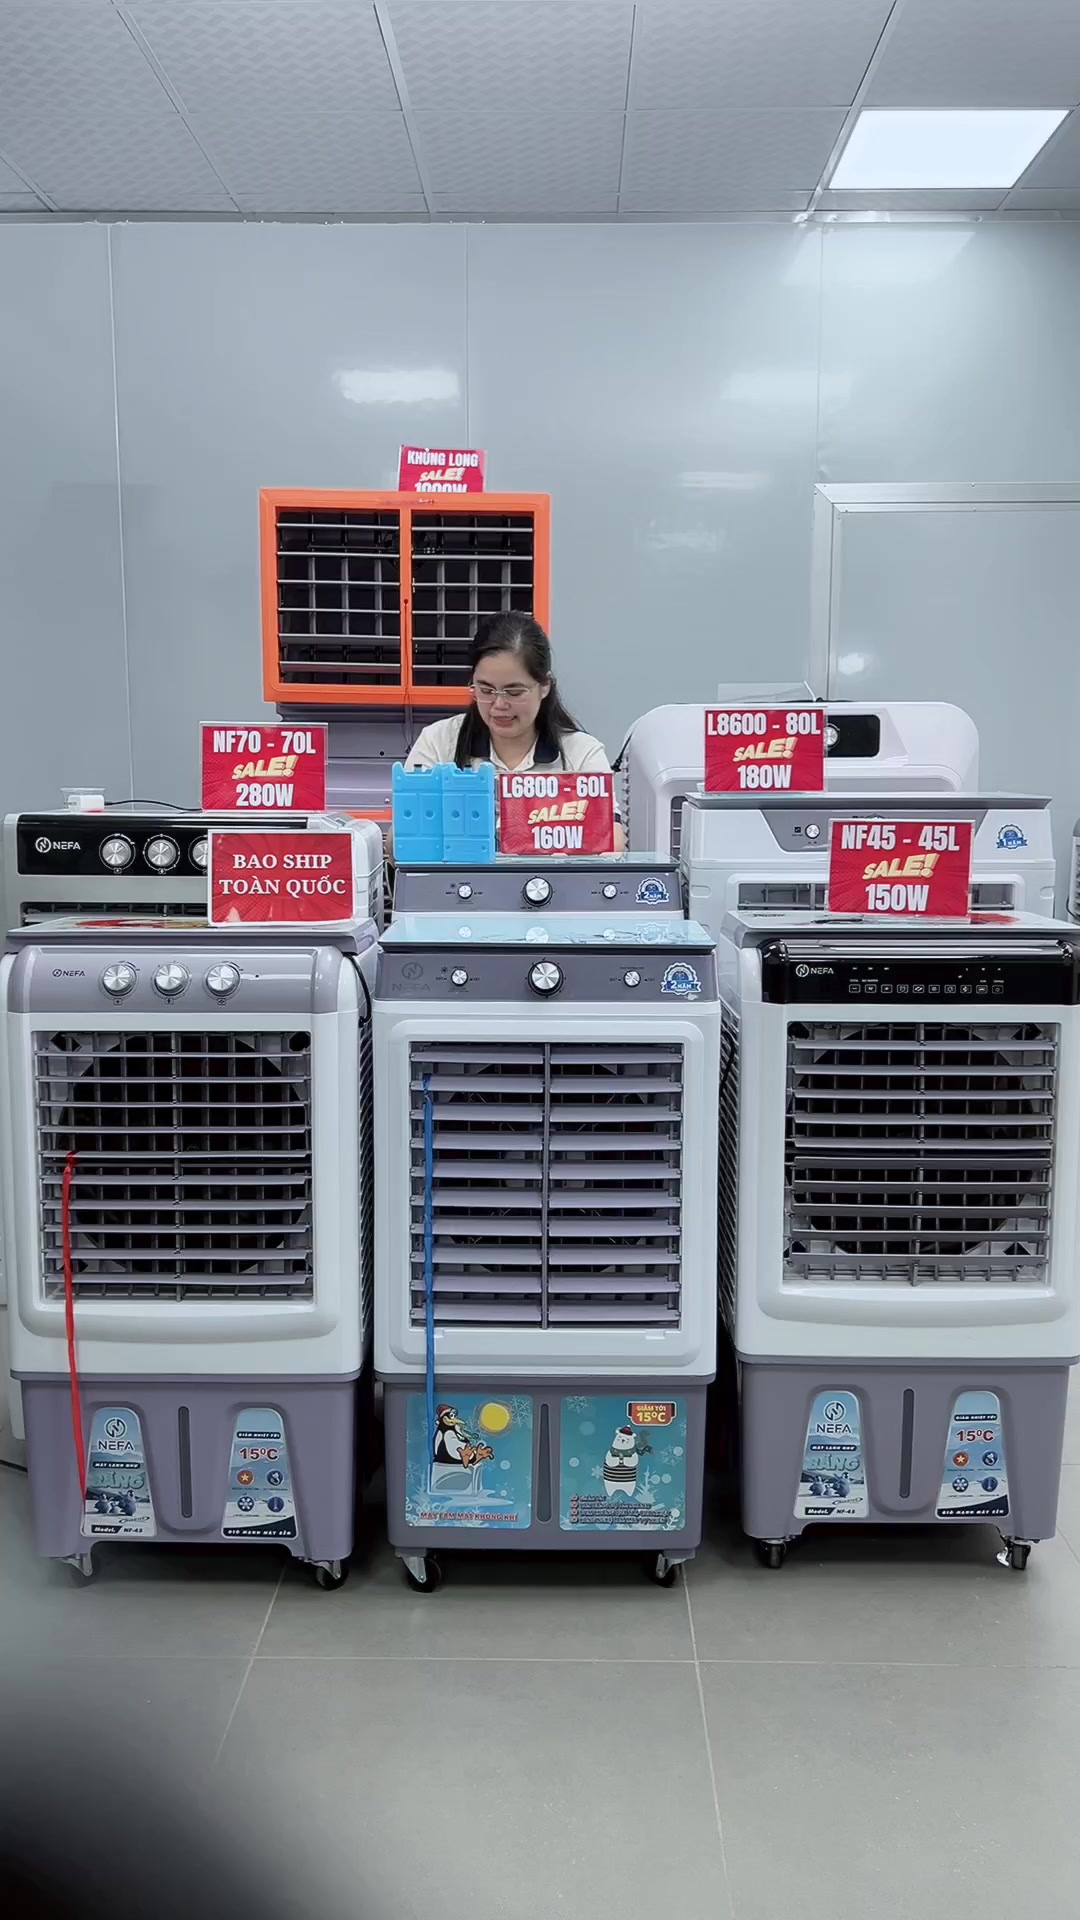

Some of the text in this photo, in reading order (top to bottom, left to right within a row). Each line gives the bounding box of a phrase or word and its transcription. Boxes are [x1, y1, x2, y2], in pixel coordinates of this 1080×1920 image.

[407, 447, 479, 468] KHỦNG LONG
[707, 712, 767, 736] L8600
[785, 712, 821, 735] 80L
[213, 730, 262, 753] NF70
[280, 731, 317, 754] 70L
[732, 736, 799, 763] SALE!
[231, 754, 299, 780] SALE!
[737, 764, 793, 789] 180W
[235, 783, 295, 807] 280W
[502, 775, 559, 798] L6800
[575, 775, 610, 798] 60L
[527, 799, 590, 825] SALE!
[52, 841, 81, 850] NEFA
[531, 825, 584, 850] 160W
[841, 824, 897, 851] NF45
[917, 825, 960, 852] 45L
[232, 853, 333, 870] BAO SHIP
[861, 852, 940, 880] SALE!
[218, 874, 347, 899] TOÀN QUỐC
[865, 883, 930, 912] 150W
[810, 967, 835, 975] NEFA
[816, 1423, 852, 1434] NEFA
[98, 1440, 134, 1451] NEFA
